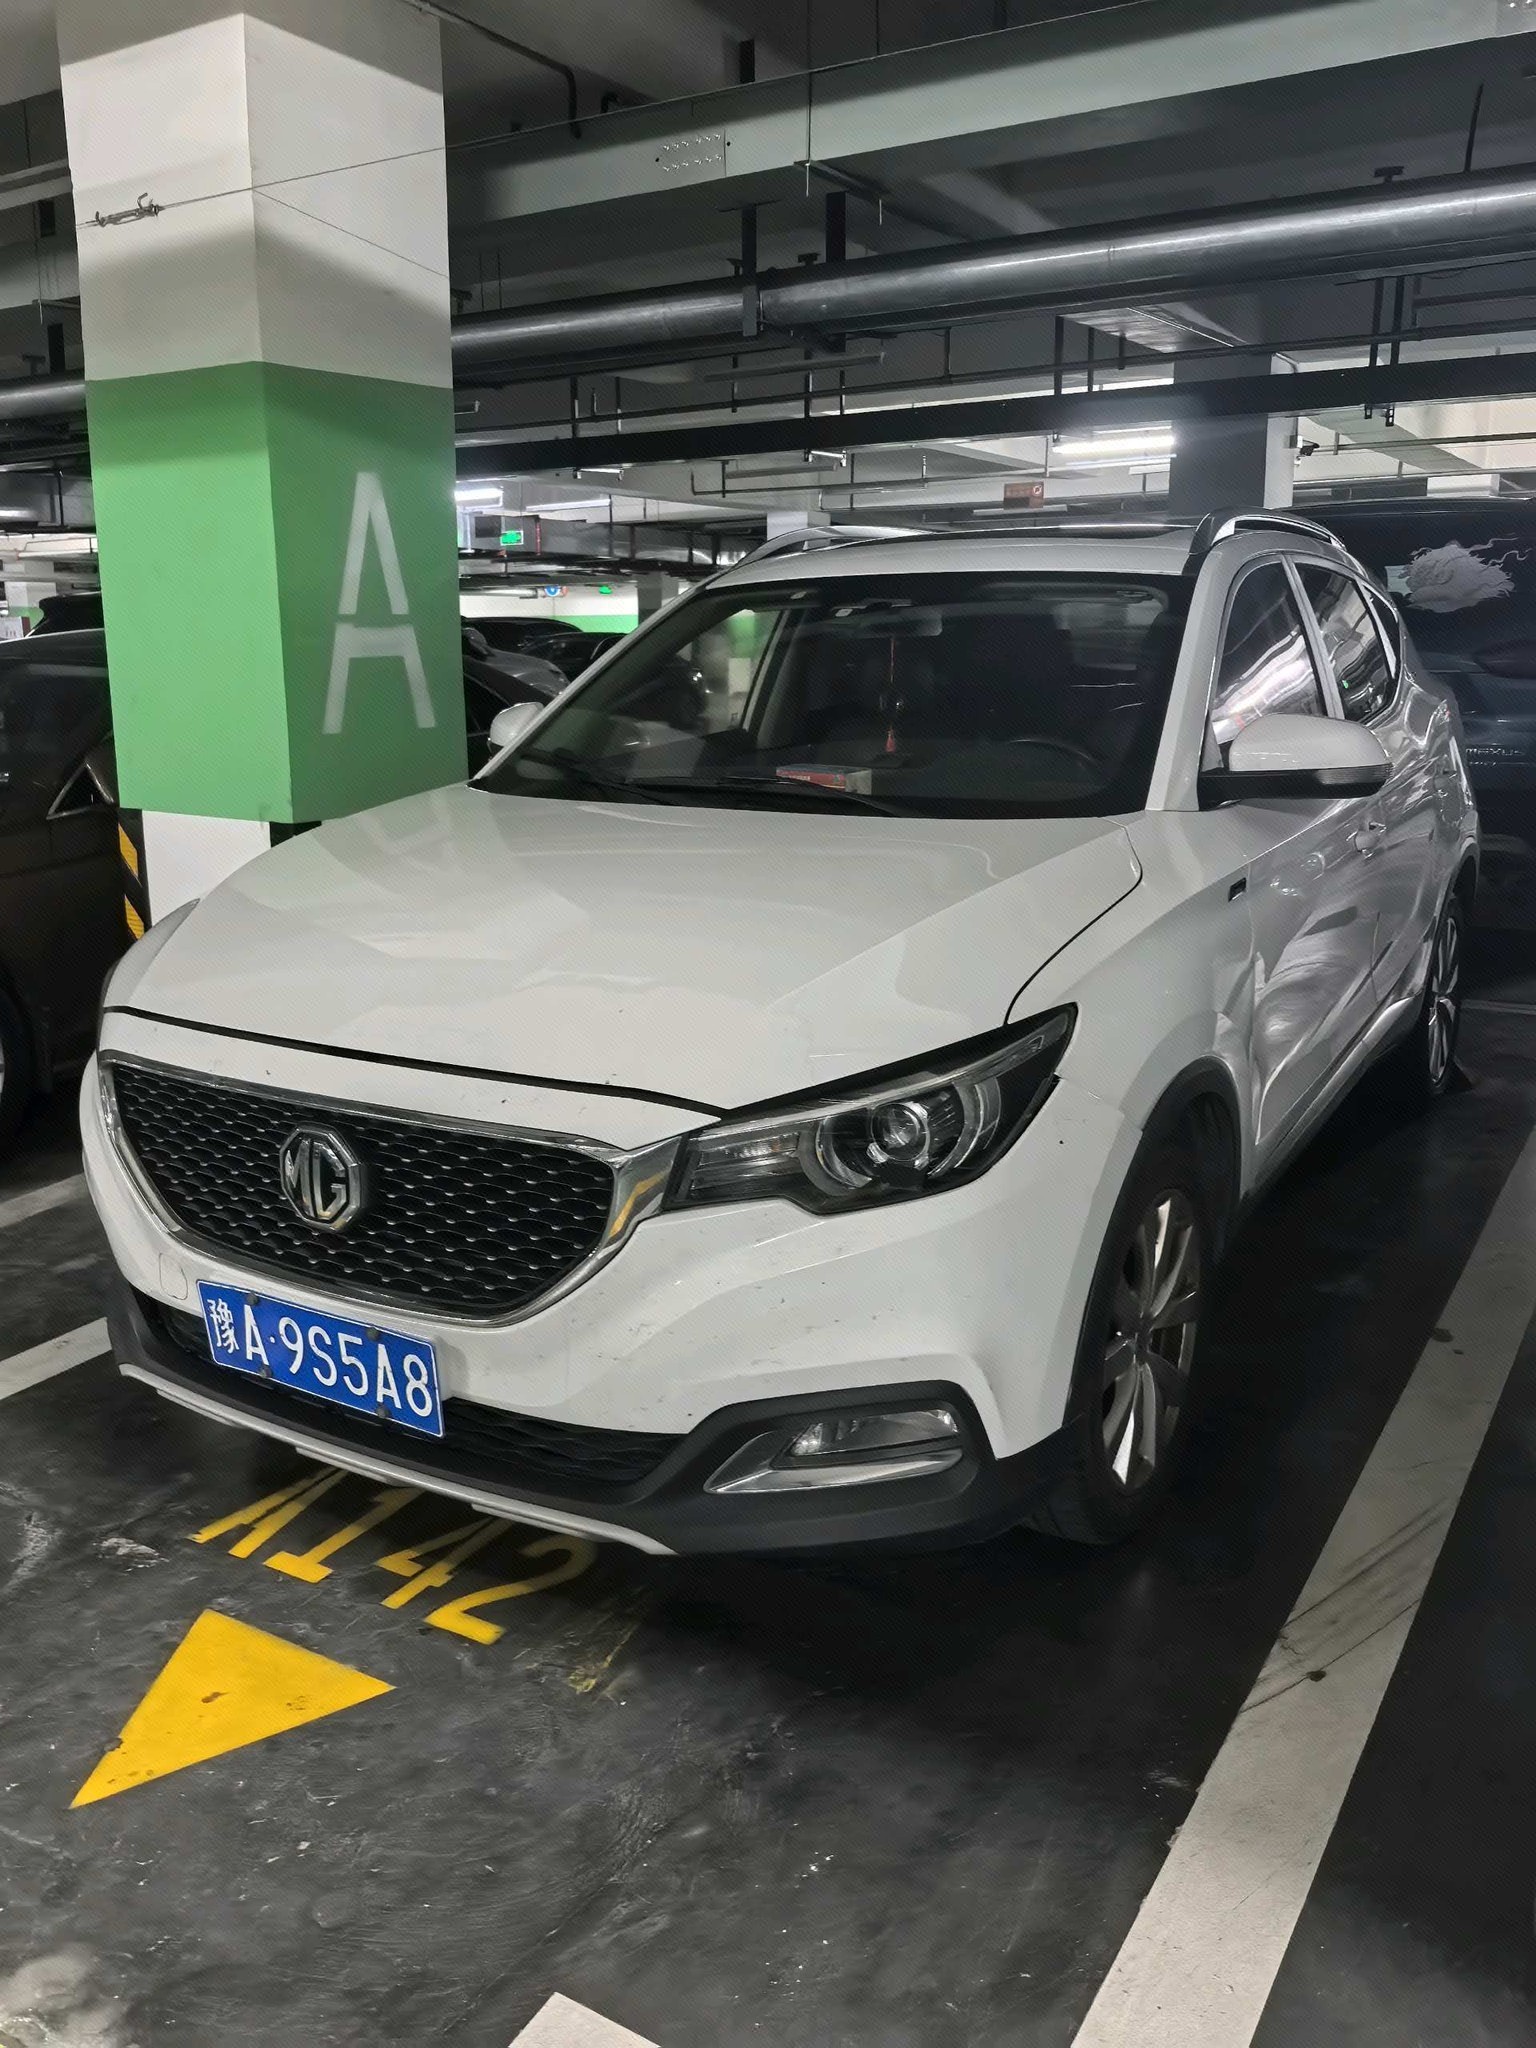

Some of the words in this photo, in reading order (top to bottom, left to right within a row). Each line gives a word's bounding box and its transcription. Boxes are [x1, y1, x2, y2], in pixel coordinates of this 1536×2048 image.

[322, 471, 436, 735] A
[284, 1138, 348, 1221] MG
[206, 1298, 434, 1418] 豫A·9S5A8
[187, 1467, 597, 1646] A142
